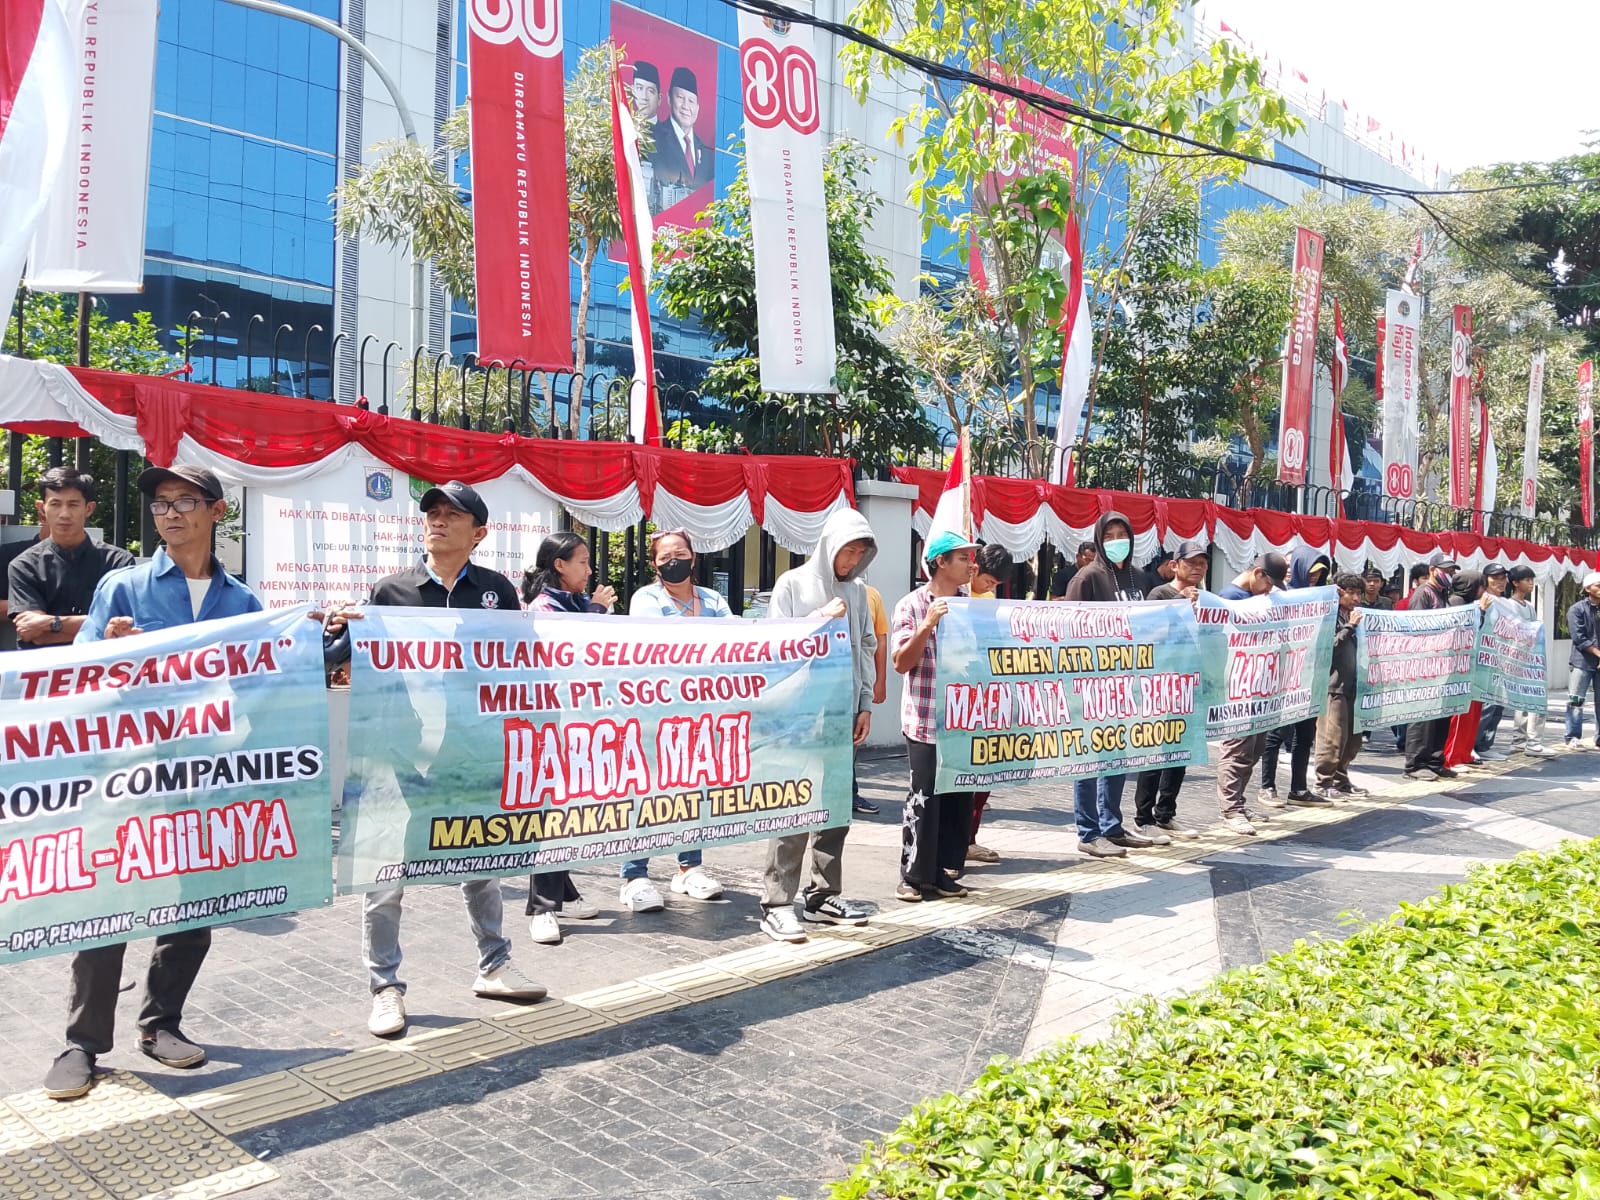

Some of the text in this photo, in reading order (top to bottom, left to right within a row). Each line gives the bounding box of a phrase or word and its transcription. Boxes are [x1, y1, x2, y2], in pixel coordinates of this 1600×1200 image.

[82, 37, 96, 132] REPUBLIK
[740, 37, 820, 135] 80
[77, 144, 91, 248] INDONESIA
[514, 71, 532, 337] DIRGAHAYU REPUBLIK INDONESIA
[782, 149, 803, 366] DIRGAHAYU REPUBLIK INDONESIA
[1392, 324, 1404, 358] Maju
[1404, 326, 1414, 400] Indonesia
[1284, 428, 1304, 469] 80
[1387, 462, 1413, 498] 80
[280, 509, 301, 519] HAK
[306, 510, 328, 520] KITA
[332, 511, 376, 523] DIBATASI
[379, 514, 403, 524] OLEH
[532, 525, 551, 534] ATAS
[373, 532, 414, 542] HAK-HAK
[276, 562, 338, 573] MENGATUR
[342, 564, 386, 574] BATASAN
[338, 543, 350, 552] UU
[352, 544, 360, 552] RI
[361, 544, 373, 552] NO
[259, 581, 350, 591] MENYAMPAIKAN
[1009, 607, 1069, 641] RAKYAT
[1267, 604, 1300, 622] SELURUH
[1301, 601, 1319, 618] AREA
[474, 641, 574, 669] ULANG
[584, 641, 708, 668] SELURUH
[710, 640, 773, 664] AREA
[1229, 632, 1259, 648] MILIK
[1277, 628, 1291, 644] SGC
[1293, 625, 1315, 642] GROUP
[988, 643, 1154, 675] KEMEN ATR BPN RI
[1228, 650, 1280, 700] HARGA
[479, 675, 766, 713] MILIK PT. SGC GROUP
[944, 681, 1012, 731] MAEN
[1016, 679, 1071, 727] MATA
[1208, 701, 1268, 723] MASYARAKAT
[4, 701, 232, 760] NAHANAN
[971, 732, 1059, 766] DENGAN
[1062, 729, 1089, 758] PT.
[1091, 726, 1127, 752] SGC
[1129, 720, 1186, 749] GROUP
[500, 711, 752, 810] HARGA MATI
[0, 749, 320, 821] OUP COMPANIES
[429, 778, 813, 850] MASYARAKAT ADAT TELADAS
[376, 861, 406, 882] ATAS
[408, 859, 443, 878] NAMA
[445, 853, 519, 875] MASYARAKAT
[581, 843, 605, 859] DPP
[604, 839, 631, 856] AKAR
[631, 832, 675, 852] LAMPUNG
[683, 829, 700, 843] DPP
[701, 824, 747, 841] PEMATANK
[754, 817, 795, 834] KERAMAT
[795, 810, 829, 826] LAMPUNG
[10, 929, 46, 952] DPP
[49, 911, 132, 945] PEMATANK
[149, 899, 217, 928] KERAMAT
[218, 886, 288, 914] LAMPUNG
